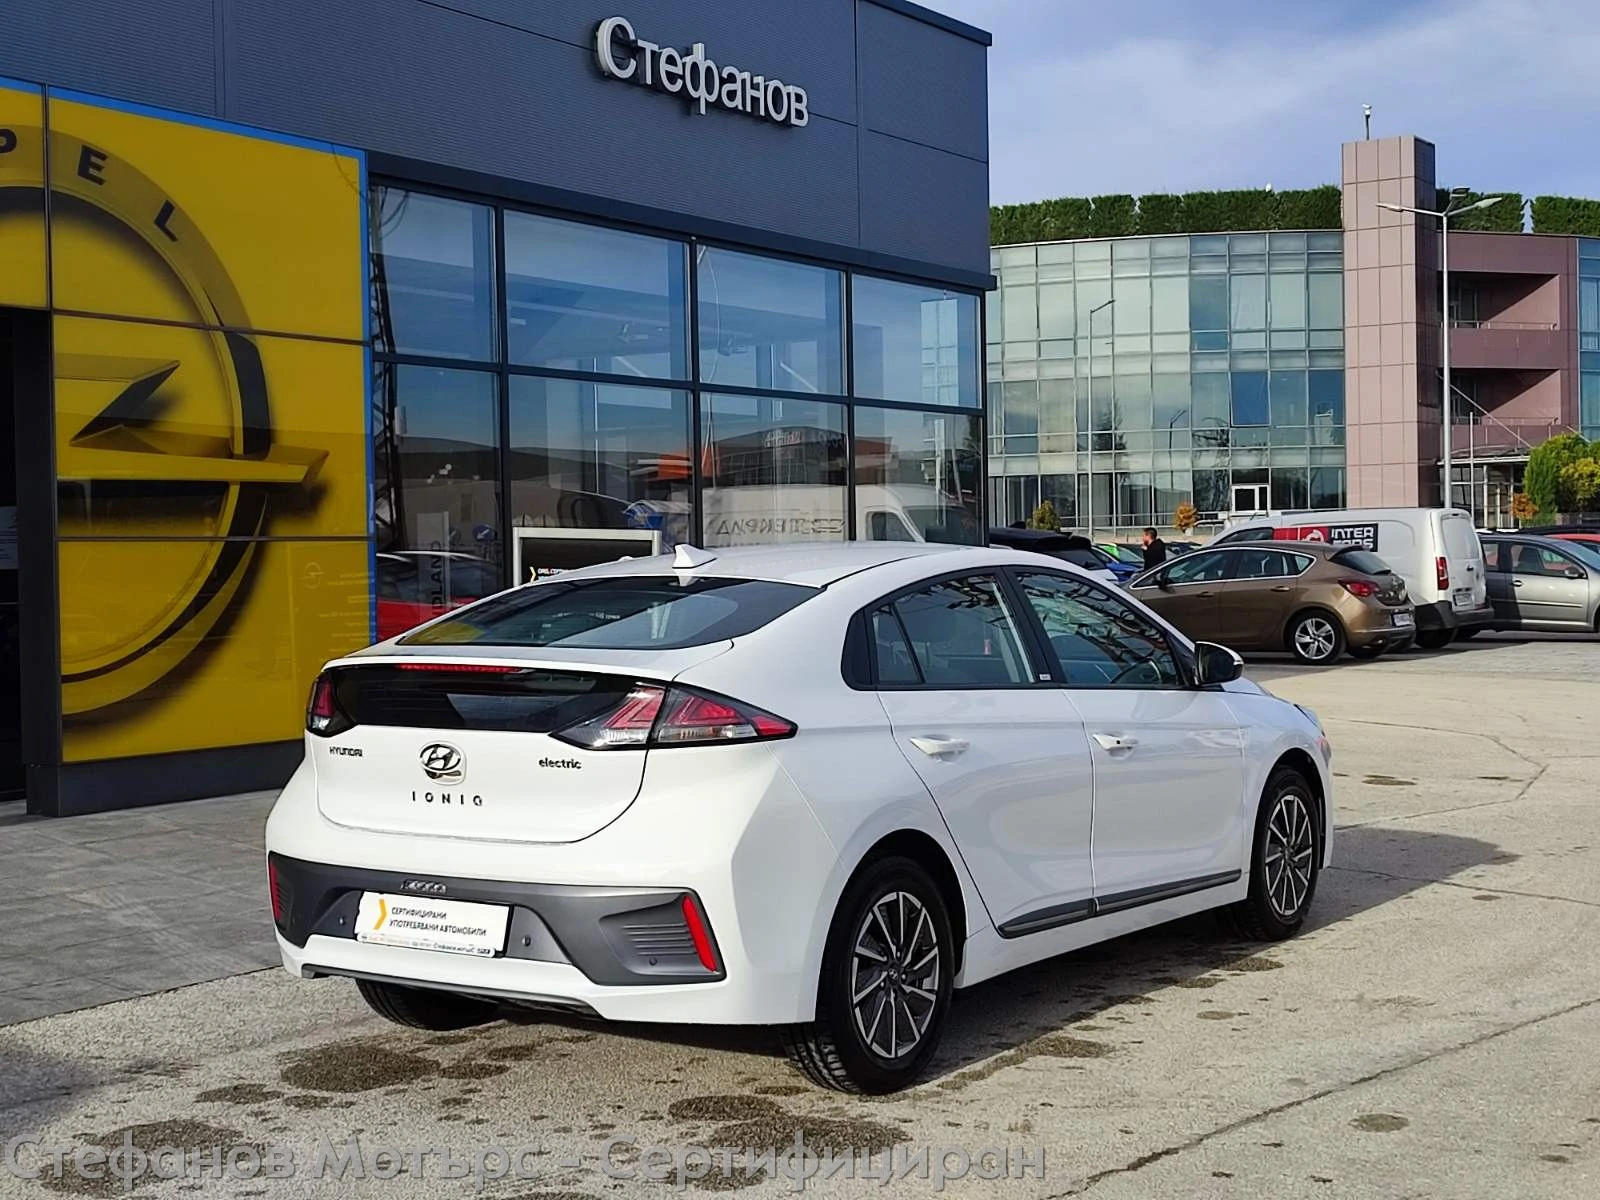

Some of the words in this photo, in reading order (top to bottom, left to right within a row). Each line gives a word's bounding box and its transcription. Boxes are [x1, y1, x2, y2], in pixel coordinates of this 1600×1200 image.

[597, 16, 809, 127] Стефанов
[1331, 527, 1374, 539] INTER
[329, 746, 363, 757] HYUNDAI
[538, 757, 582, 769] electric
[412, 791, 483, 806] IONIQ
[391, 906, 447, 920] СЕРТИФИЦИРАНИ
[439, 924, 487, 937] АВТОМОБИЛИ
